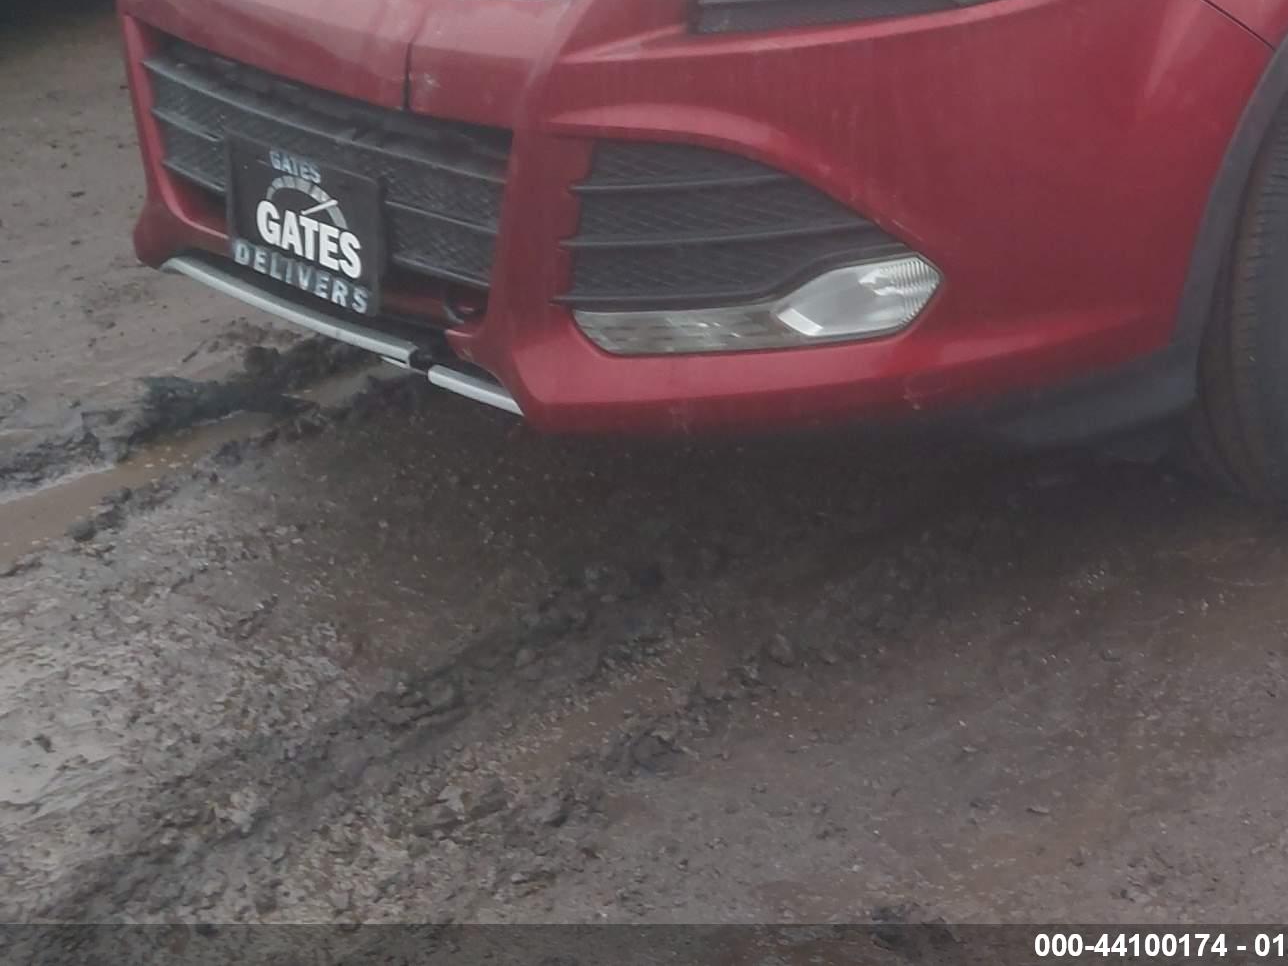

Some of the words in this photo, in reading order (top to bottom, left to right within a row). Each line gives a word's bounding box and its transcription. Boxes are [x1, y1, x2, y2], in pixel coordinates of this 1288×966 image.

[269, 149, 322, 184] GATES
[233, 239, 369, 314] DELIVERS
[256, 200, 362, 279] GATES
